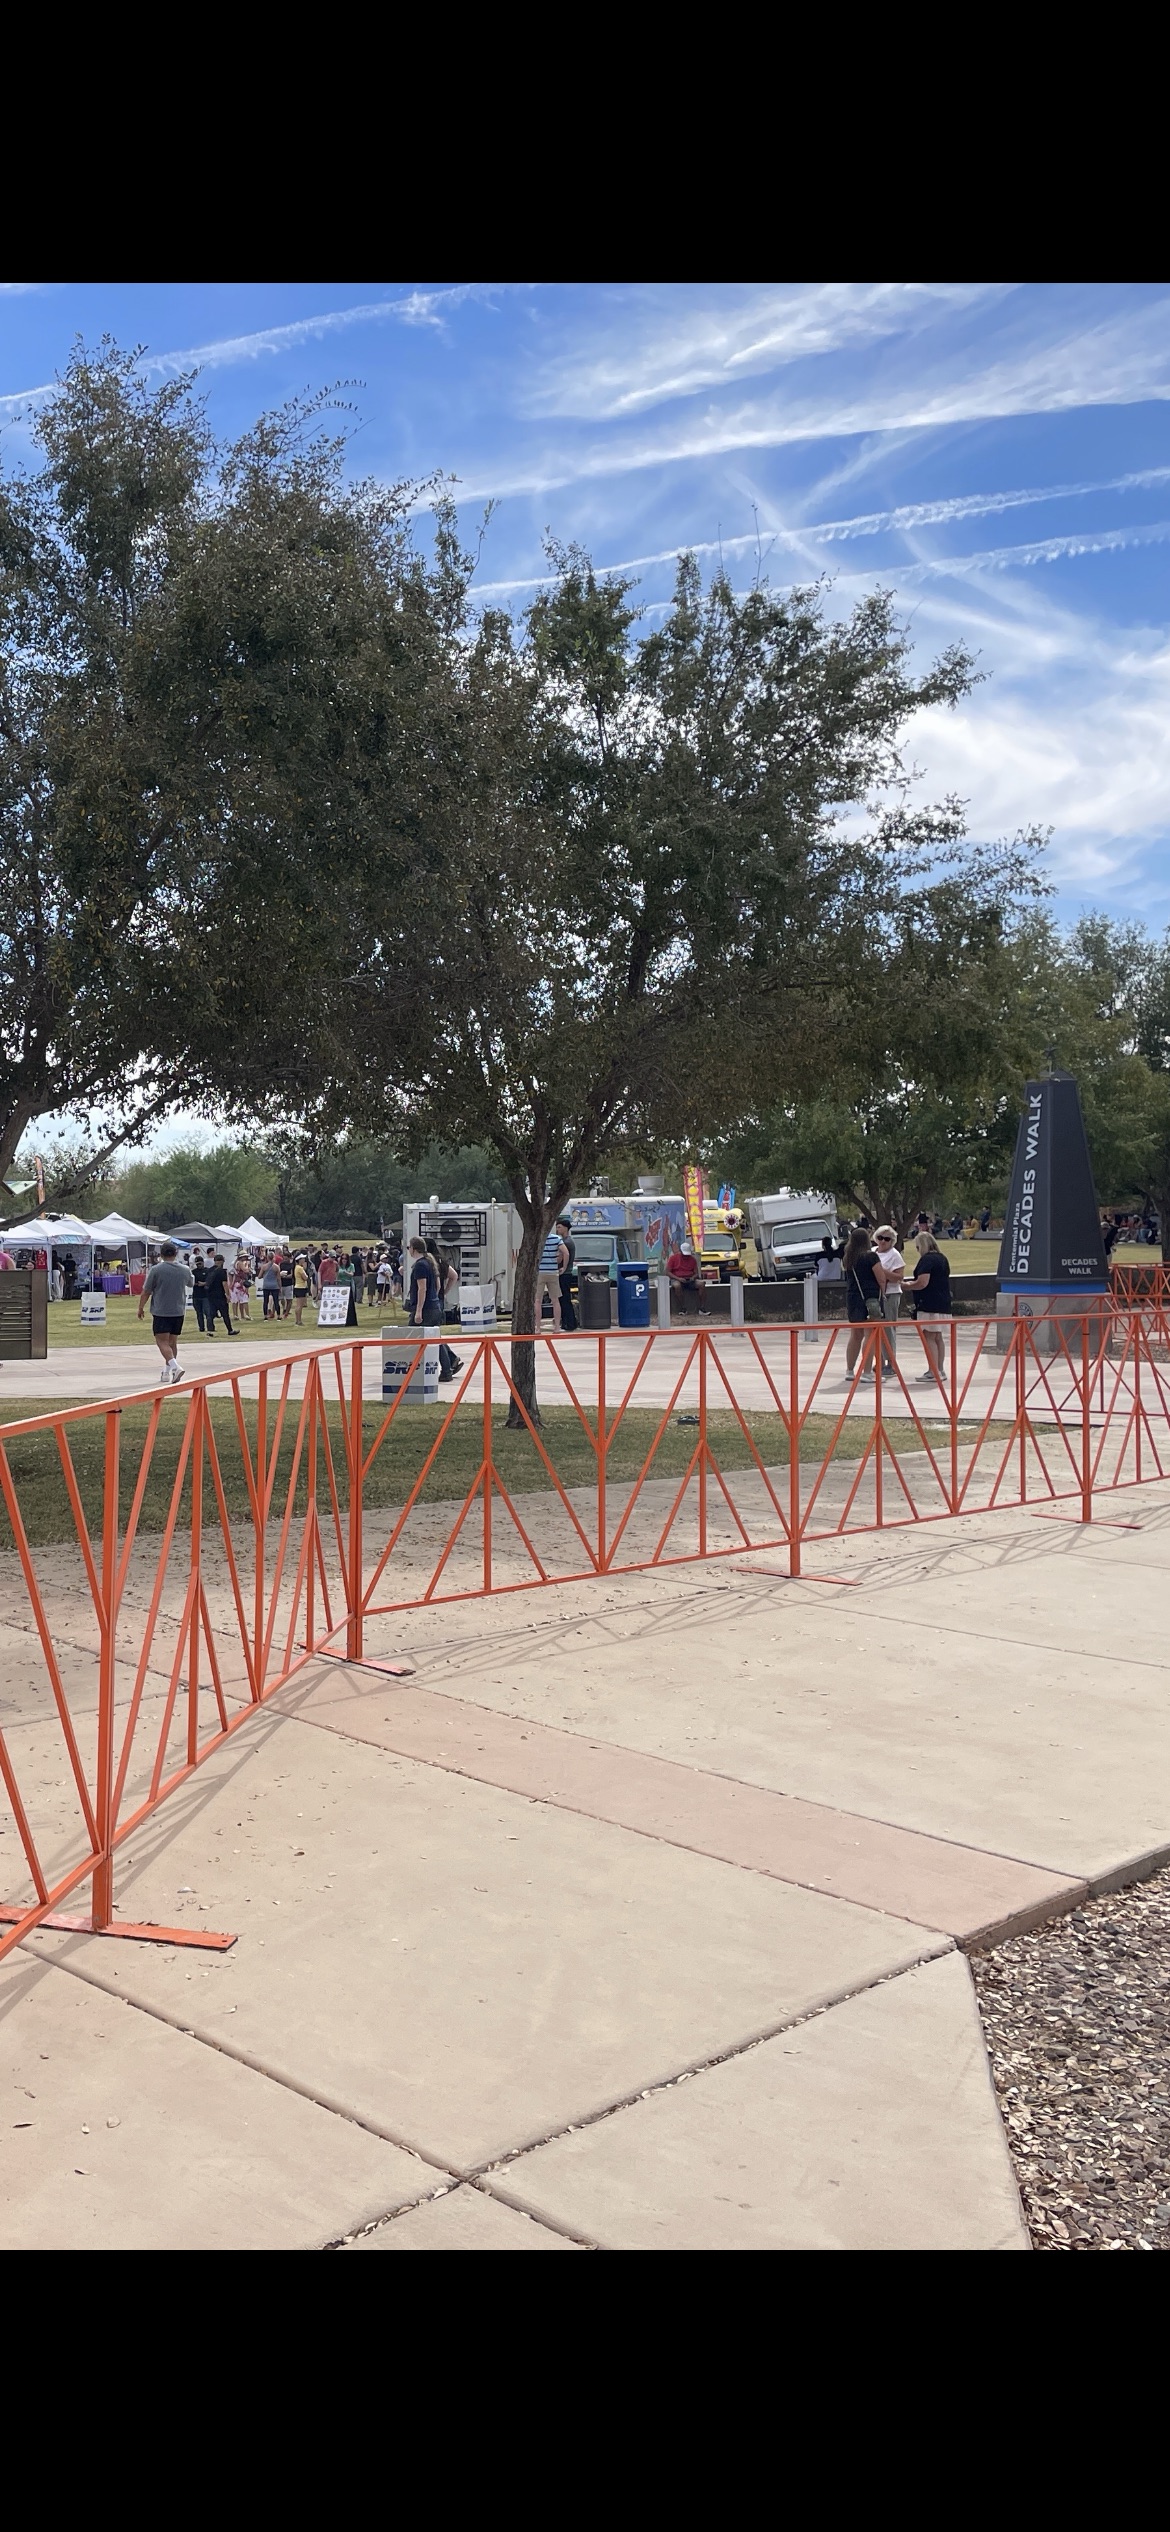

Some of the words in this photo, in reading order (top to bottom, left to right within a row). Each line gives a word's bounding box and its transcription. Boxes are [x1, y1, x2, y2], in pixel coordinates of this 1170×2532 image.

[1025, 1094, 1042, 1160] WALK
[1013, 1203, 1021, 1225] Plaza
[1017, 1169, 1036, 1273] DECADES
[1009, 1227, 1019, 1273] Centennial
[1061, 1258, 1098, 1266] DECADES
[1068, 1267, 1092, 1275] WALK
[461, 1306, 480, 1314] SRP
